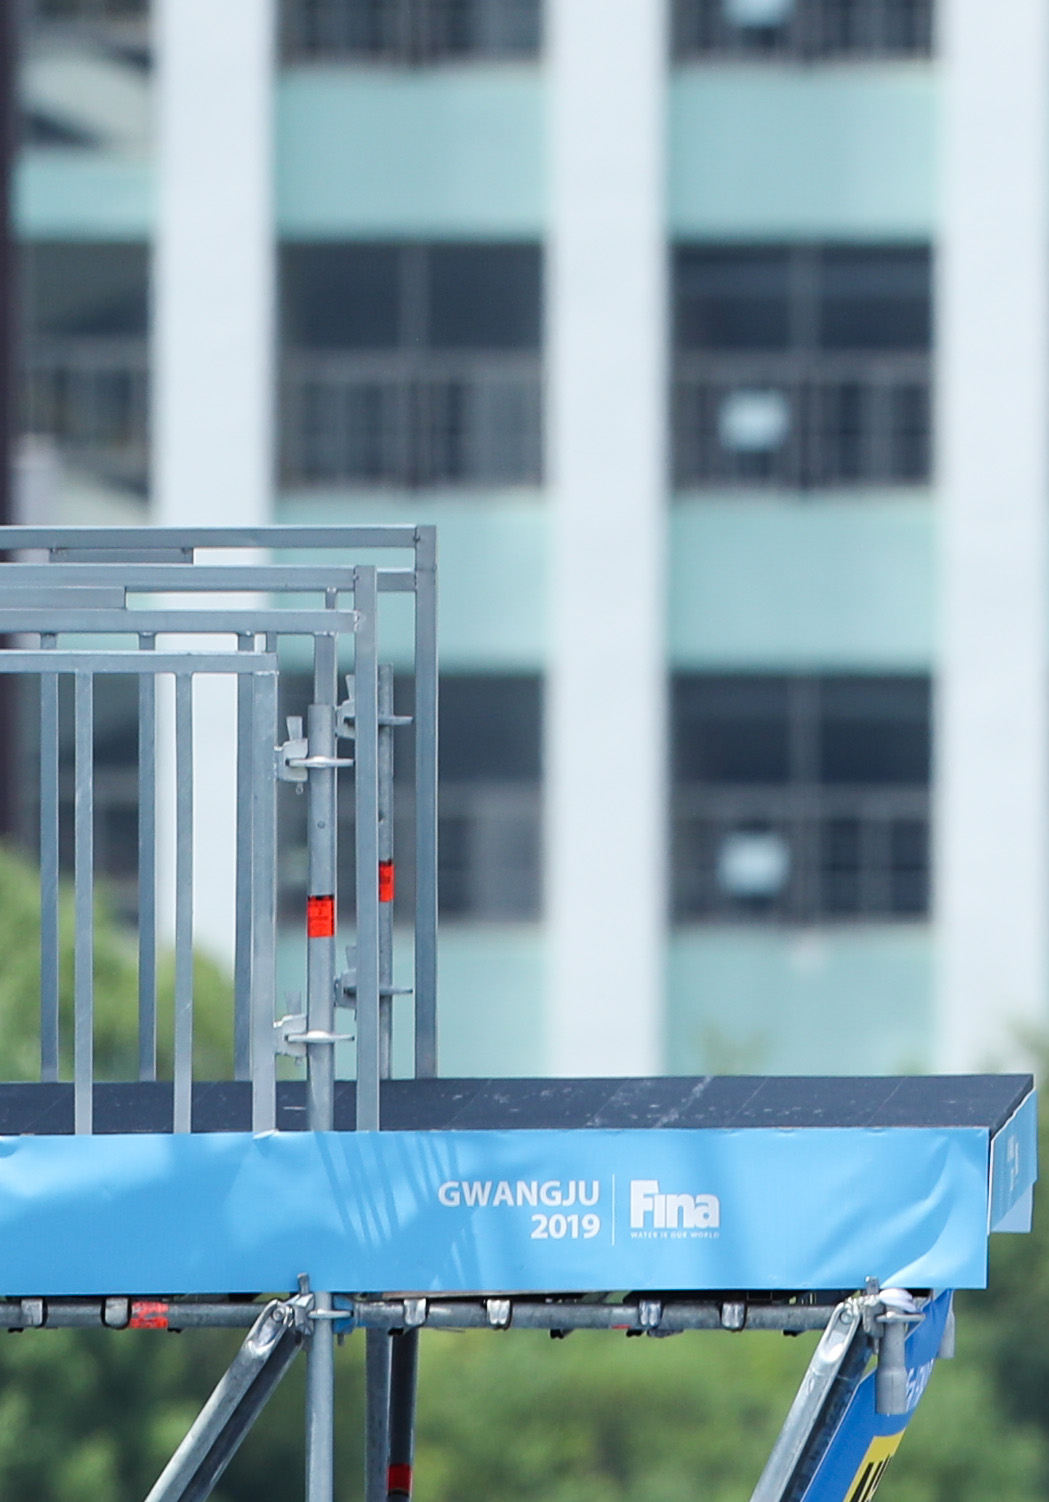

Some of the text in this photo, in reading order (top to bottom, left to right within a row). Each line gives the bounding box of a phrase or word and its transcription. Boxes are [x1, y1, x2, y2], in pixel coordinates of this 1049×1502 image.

[438, 1180, 600, 1207] GWANGJU
[530, 1214, 600, 1239] 2019
[630, 1231, 658, 1239] WATER
[660, 1231, 668, 1239] IS
[690, 1231, 720, 1239] WORLD
